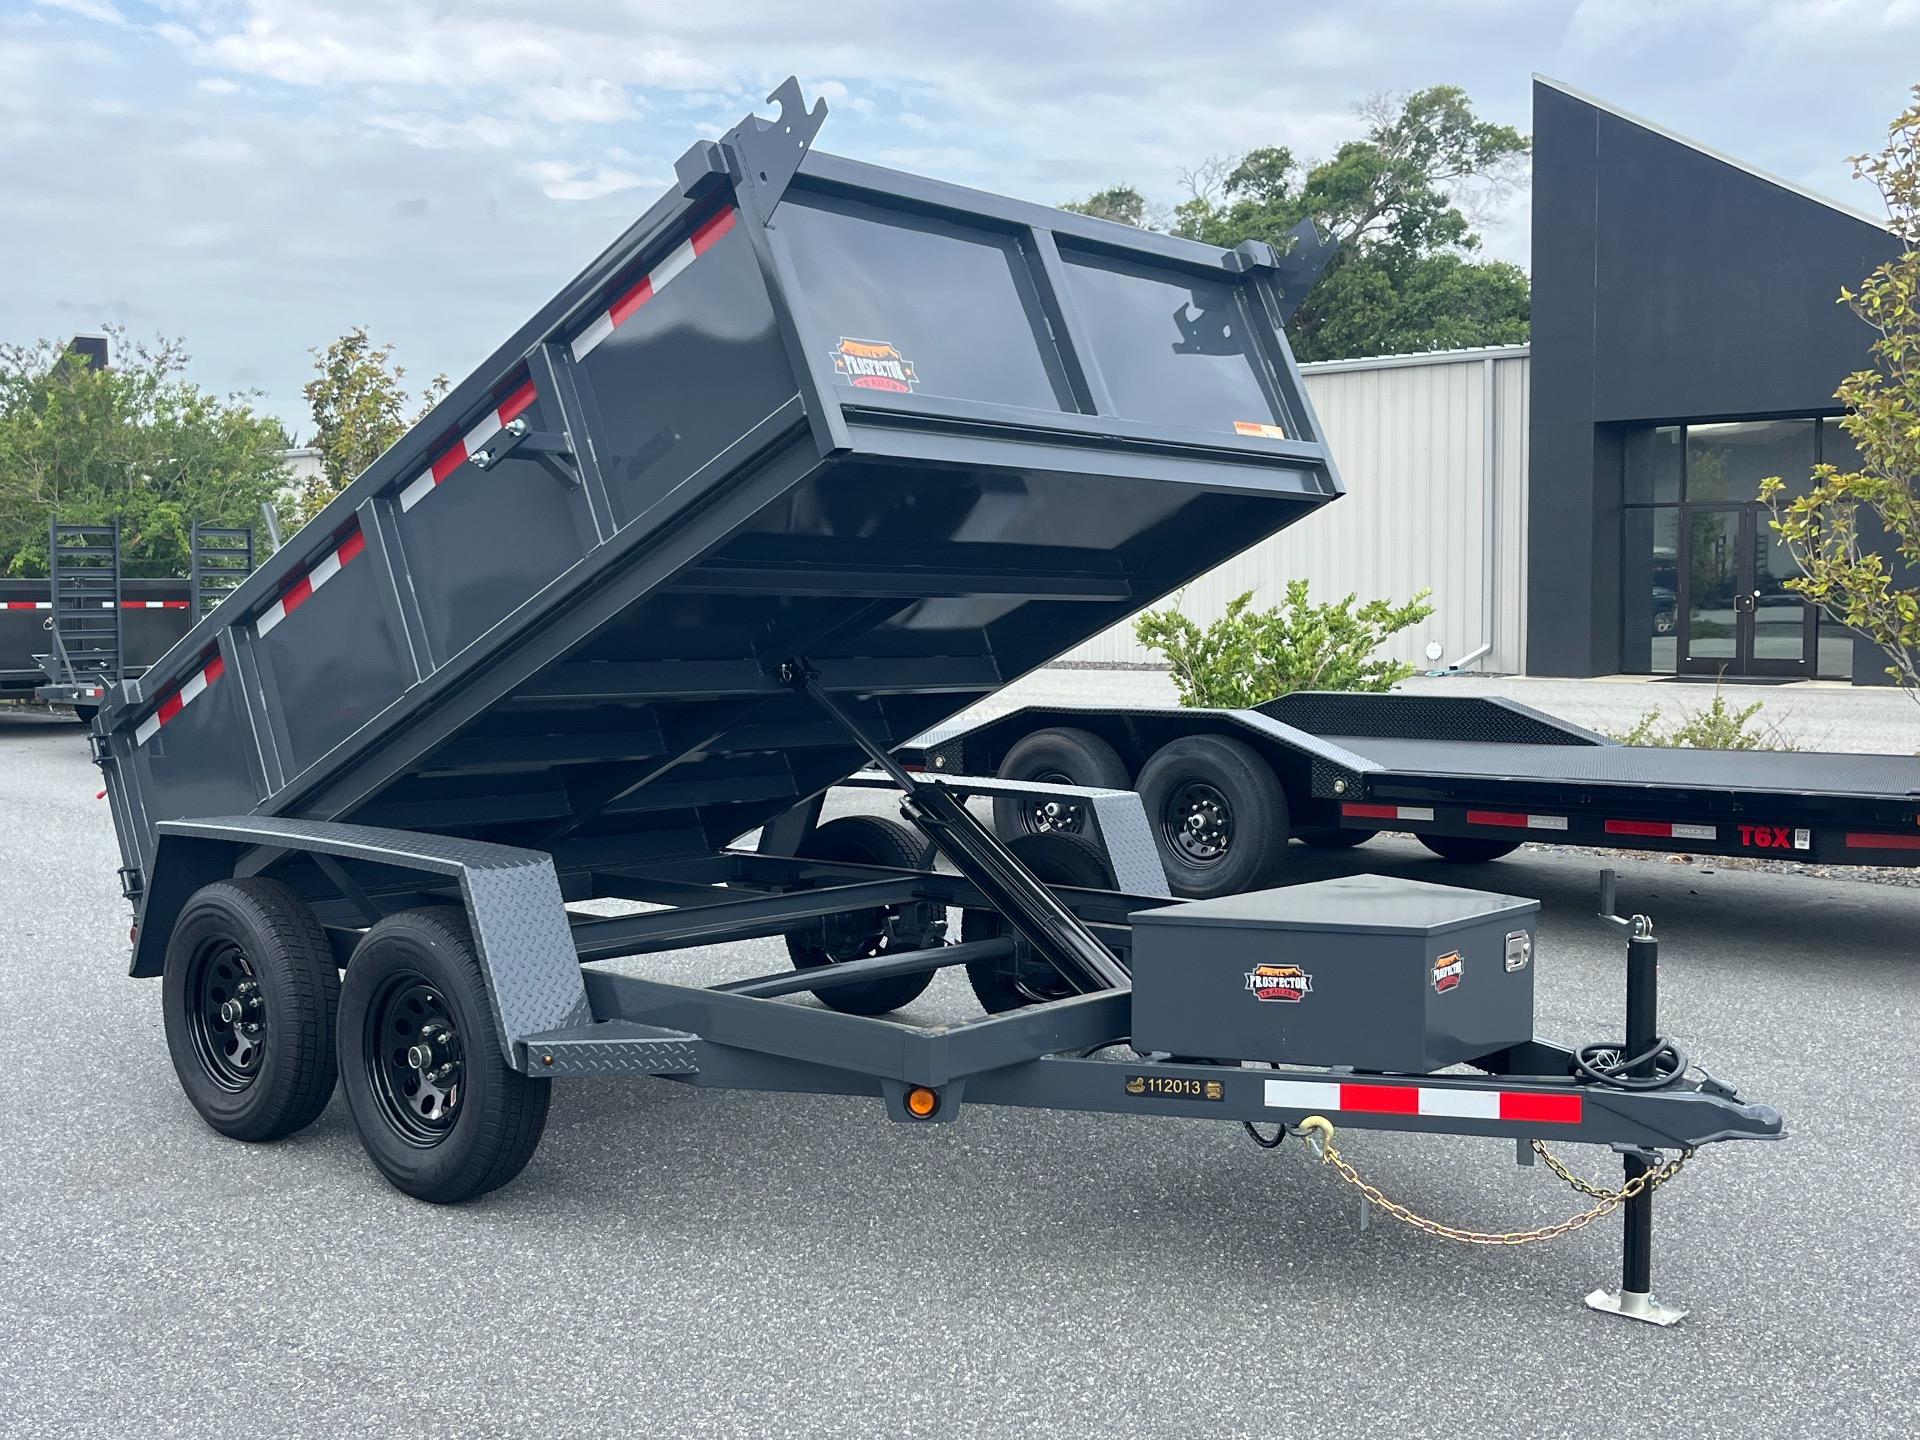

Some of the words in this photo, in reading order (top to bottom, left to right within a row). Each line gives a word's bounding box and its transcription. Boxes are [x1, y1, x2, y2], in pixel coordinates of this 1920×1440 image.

[843, 354, 906, 380] PROSPECTOR
[1737, 824, 1790, 849] T6X
[1249, 974, 1308, 990] PROSPECTOR
[1261, 989, 1298, 998] TRAILERS
[1148, 1078, 1201, 1094] 112013
